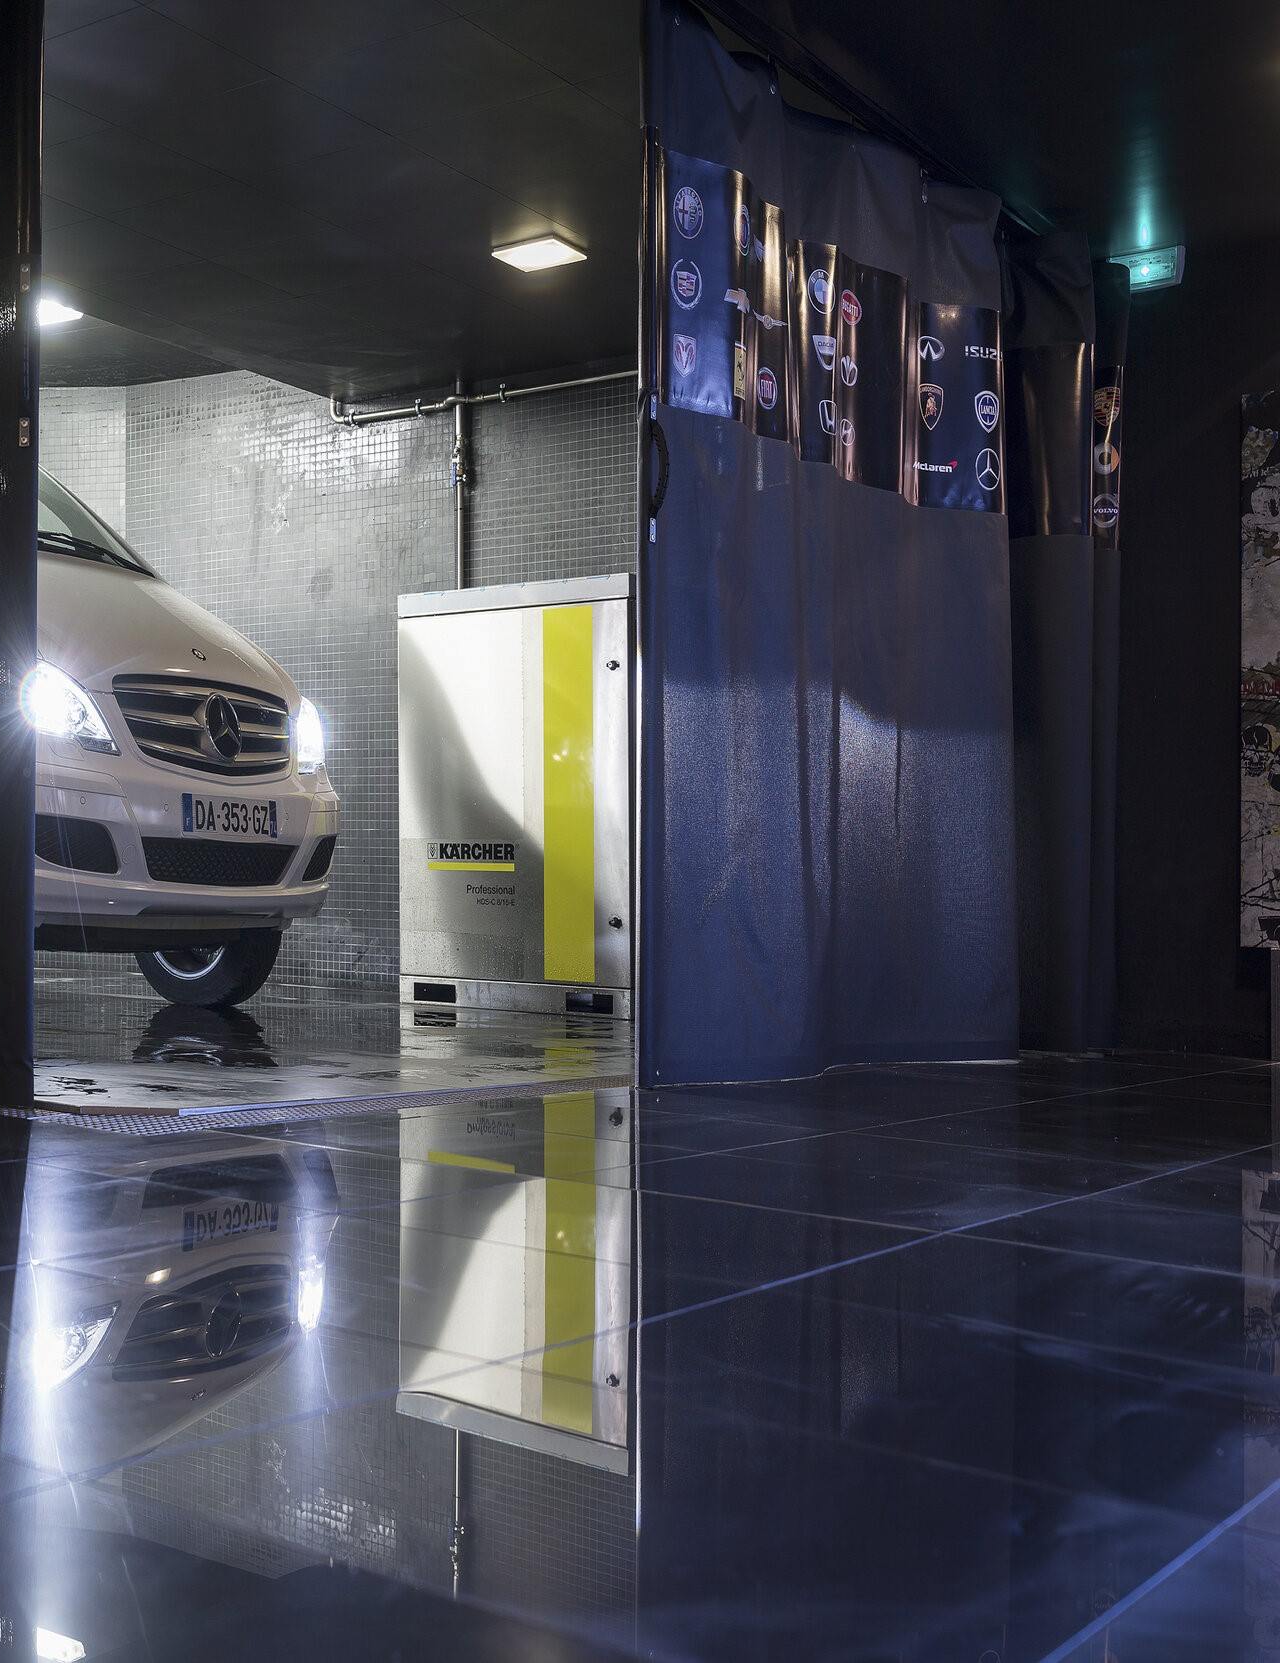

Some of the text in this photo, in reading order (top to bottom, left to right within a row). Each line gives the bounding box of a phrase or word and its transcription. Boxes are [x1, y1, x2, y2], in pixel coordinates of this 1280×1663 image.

[760, 379, 773, 399] FIAT
[980, 404, 995, 416] LANCIA
[913, 460, 953, 473] McLaren
[1093, 506, 1119, 514] VOLVO
[439, 842, 515, 861] KÄRCHER
[466, 884, 516, 895] Professional
